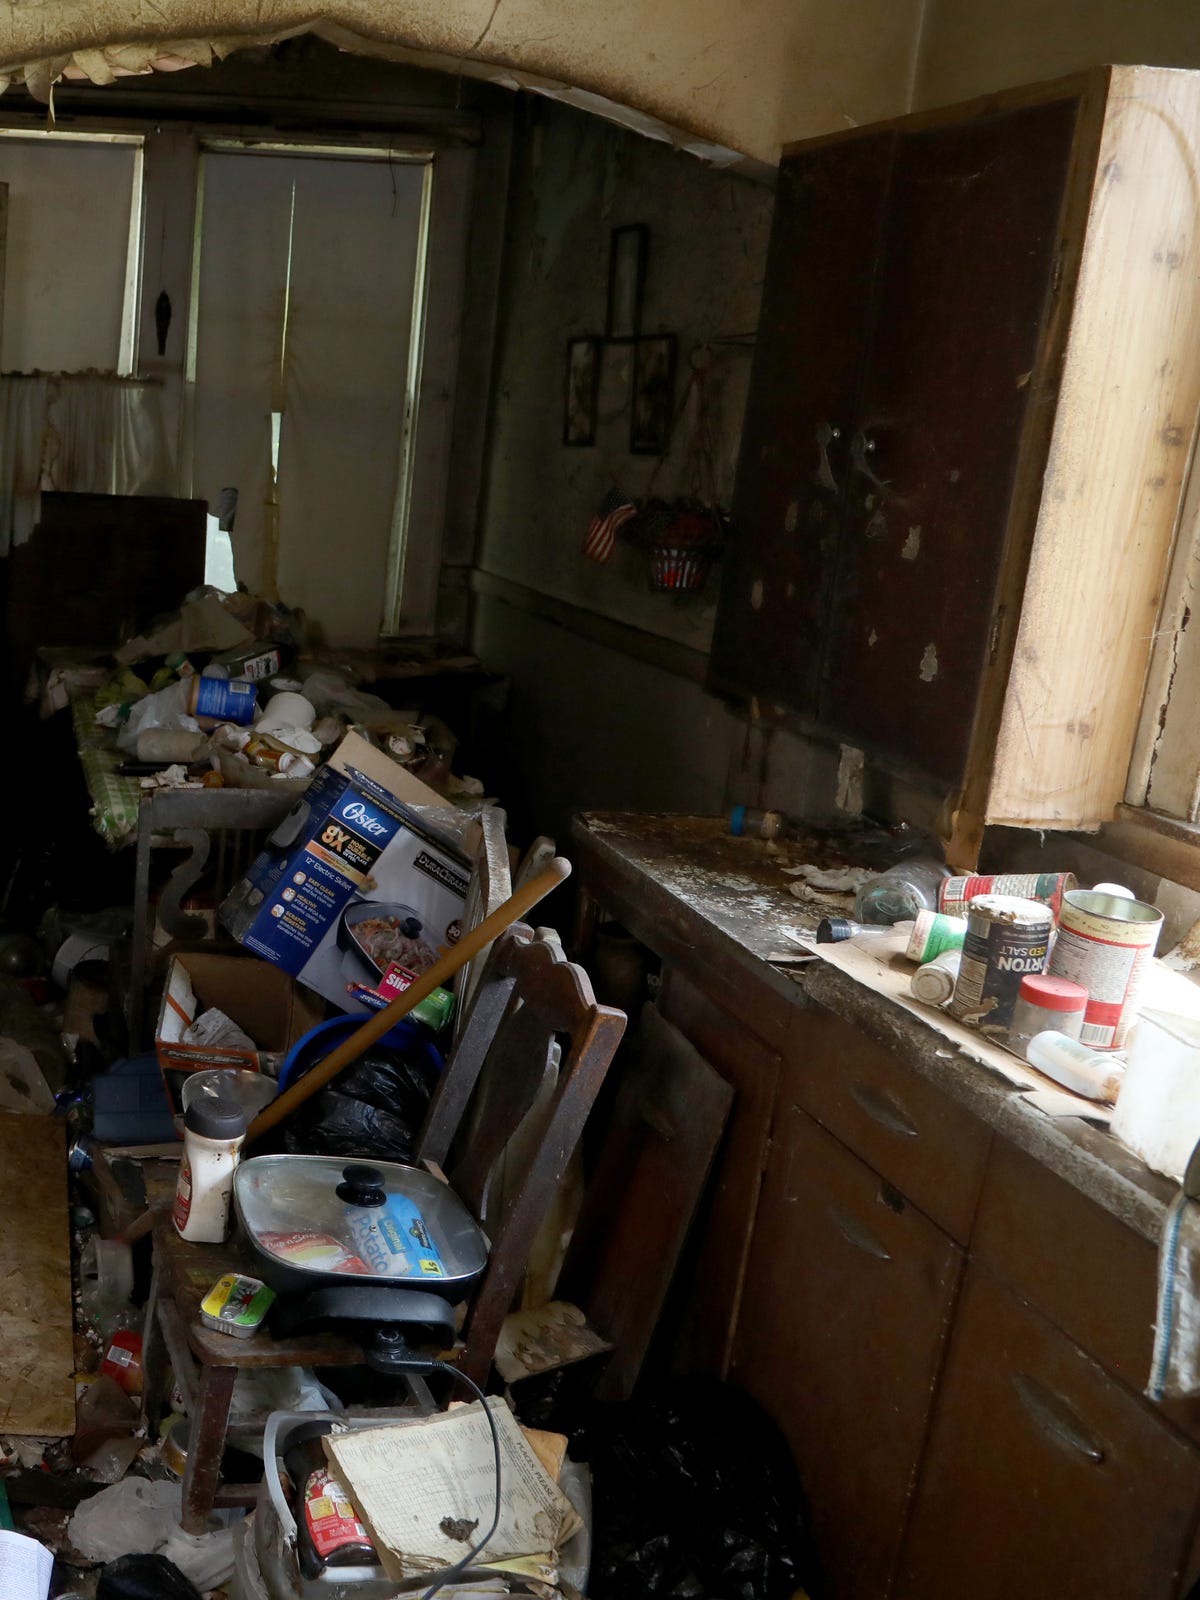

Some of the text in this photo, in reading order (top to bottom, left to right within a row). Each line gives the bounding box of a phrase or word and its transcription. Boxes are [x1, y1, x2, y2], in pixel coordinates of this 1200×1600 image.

[342, 802, 388, 836] Oster
[321, 825, 351, 852] 8X
[350, 839, 366, 852] MORE
[313, 862, 334, 880] Electric
[334, 876, 352, 891] Skillet
[1000, 945, 1028, 956] SALT
[168, 1051, 213, 1062] Proctor
[352, 1214, 388, 1273] Potato
[383, 1217, 404, 1251] Original
[516, 1442, 534, 1470] PLACES,
[535, 1471, 554, 1497] PLEASE
